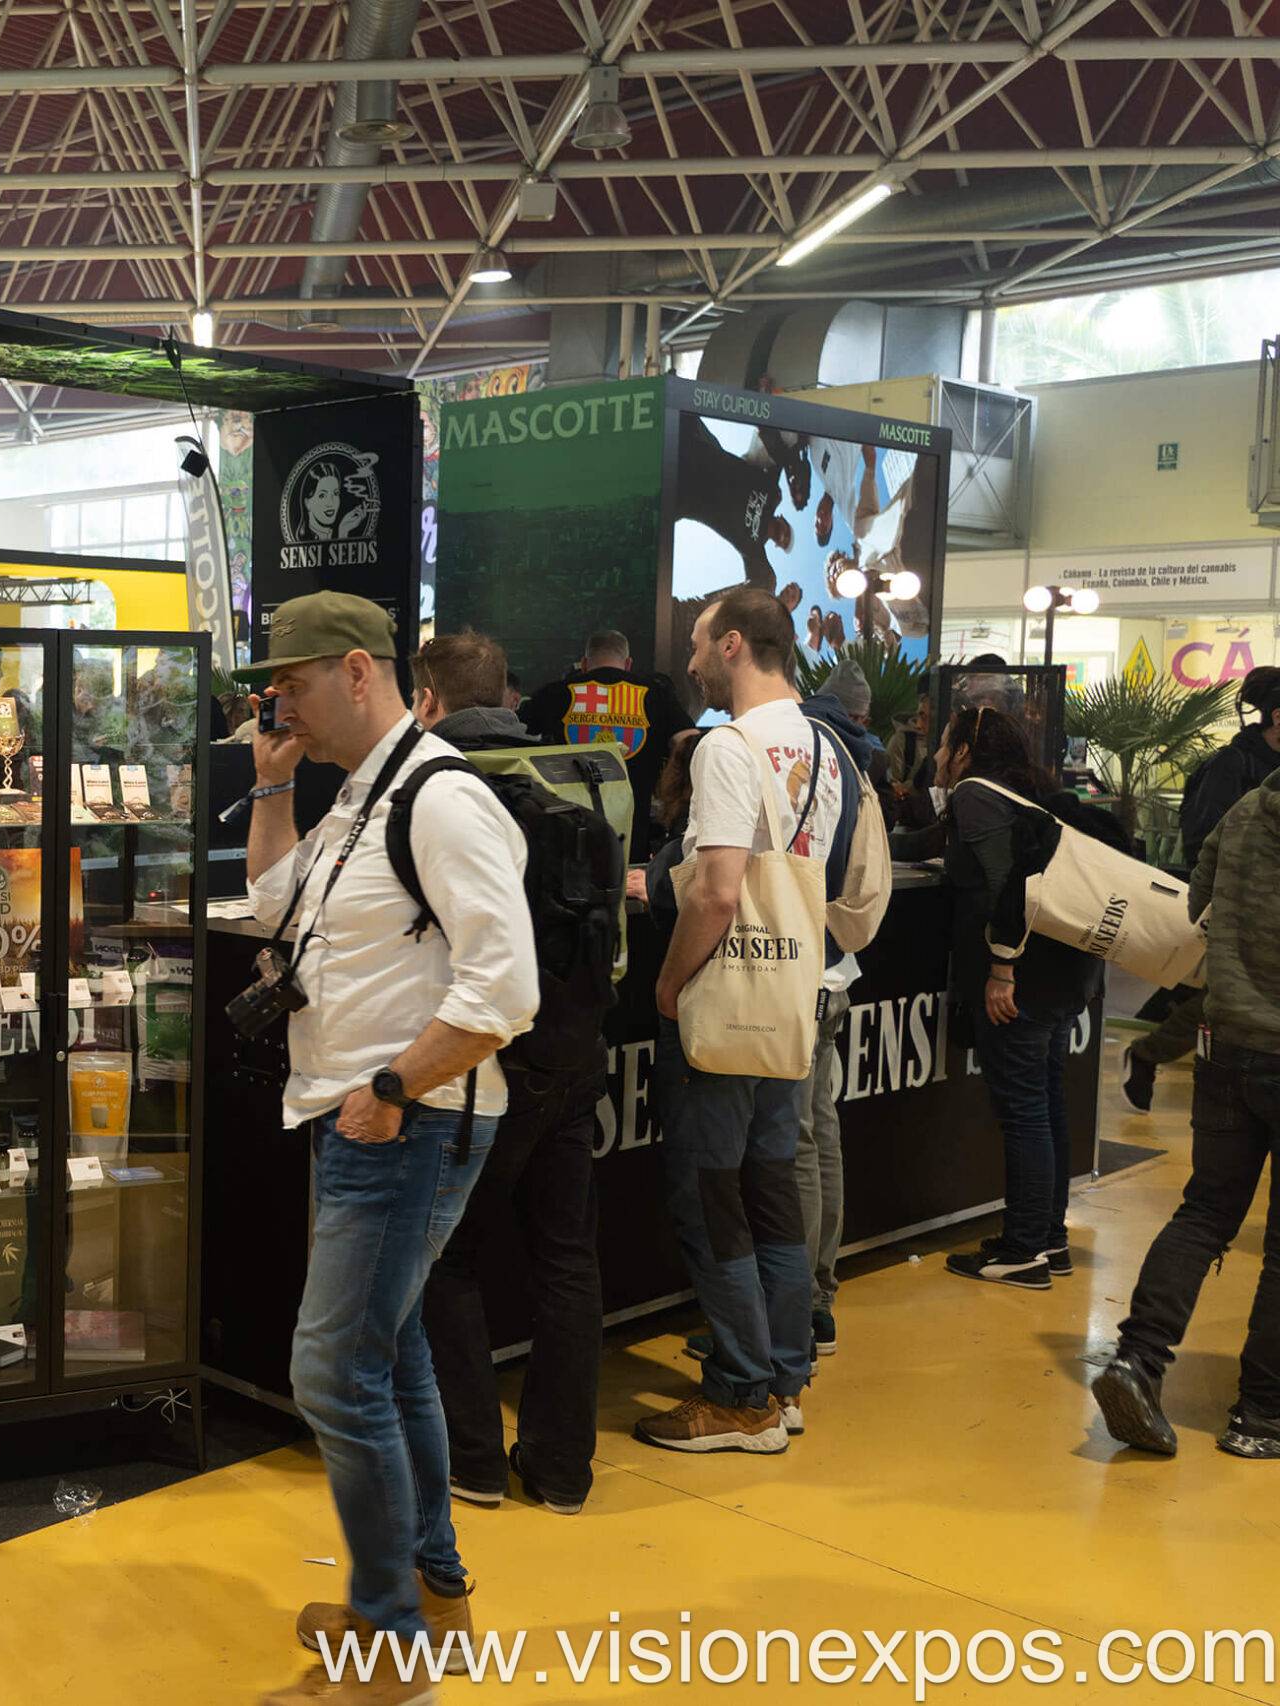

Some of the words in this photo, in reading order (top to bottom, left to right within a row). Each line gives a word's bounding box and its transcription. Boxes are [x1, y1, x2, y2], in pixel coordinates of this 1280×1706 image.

[693, 387, 720, 409] STAY
[722, 394, 770, 419] CURIOUS
[443, 391, 654, 450] MASCOTTE
[879, 423, 931, 447] MASCOTTE
[280, 545, 322, 570] SENSI
[328, 541, 378, 566] SEEDS
[1099, 568, 1108, 577] La
[1109, 566, 1136, 577] revista
[1137, 566, 1147, 575] de
[1149, 566, 1155, 575] la
[1158, 564, 1185, 575] cultura
[1186, 564, 1199, 573] del
[1200, 563, 1236, 573] cannabis
[1151, 576, 1170, 586] Chile
[569, 713, 597, 723] SERGE
[599, 714, 646, 726] CANNABIS
[1094, 897, 1129, 945] SEEDS
